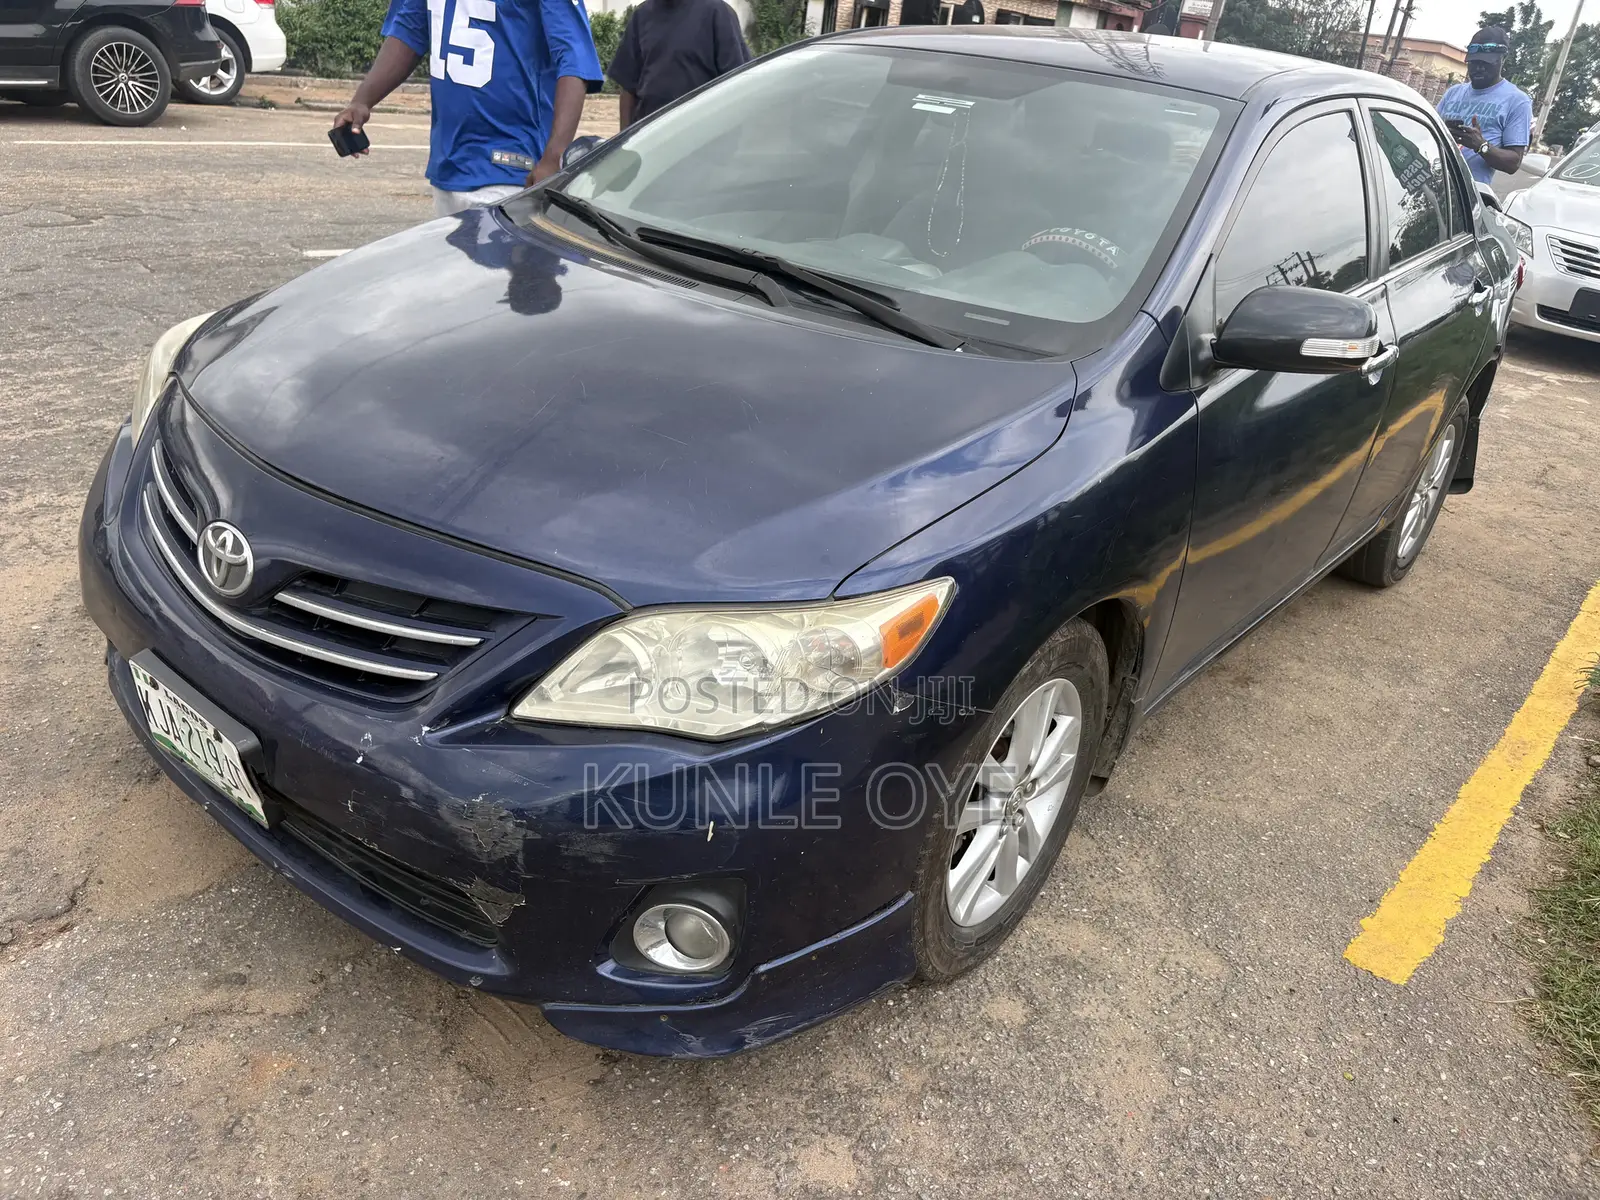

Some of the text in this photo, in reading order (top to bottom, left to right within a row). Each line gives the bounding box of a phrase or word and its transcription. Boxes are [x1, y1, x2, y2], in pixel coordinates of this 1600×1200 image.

[427, 0, 496, 88] 15
[1444, 100, 1502, 118] CAPTAIN
[164, 689, 208, 730] LAGOS
